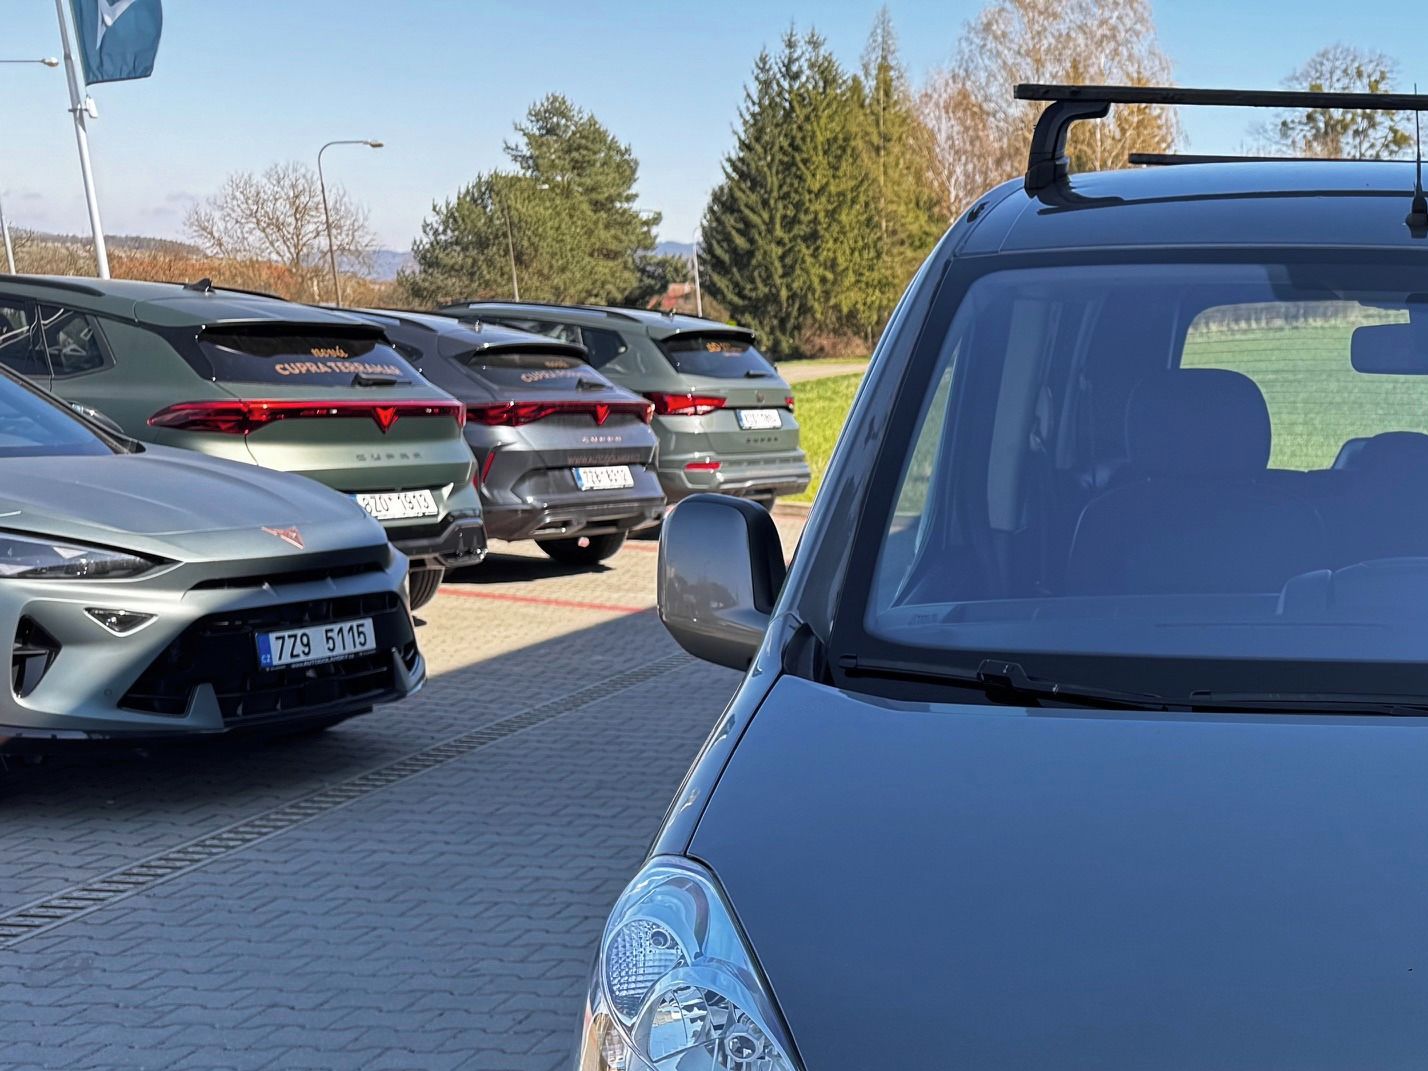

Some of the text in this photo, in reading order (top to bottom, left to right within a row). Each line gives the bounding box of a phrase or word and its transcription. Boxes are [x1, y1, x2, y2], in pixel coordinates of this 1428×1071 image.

[275, 362, 331, 376] CUPRA
[275, 623, 367, 661] 7Z9 5115
